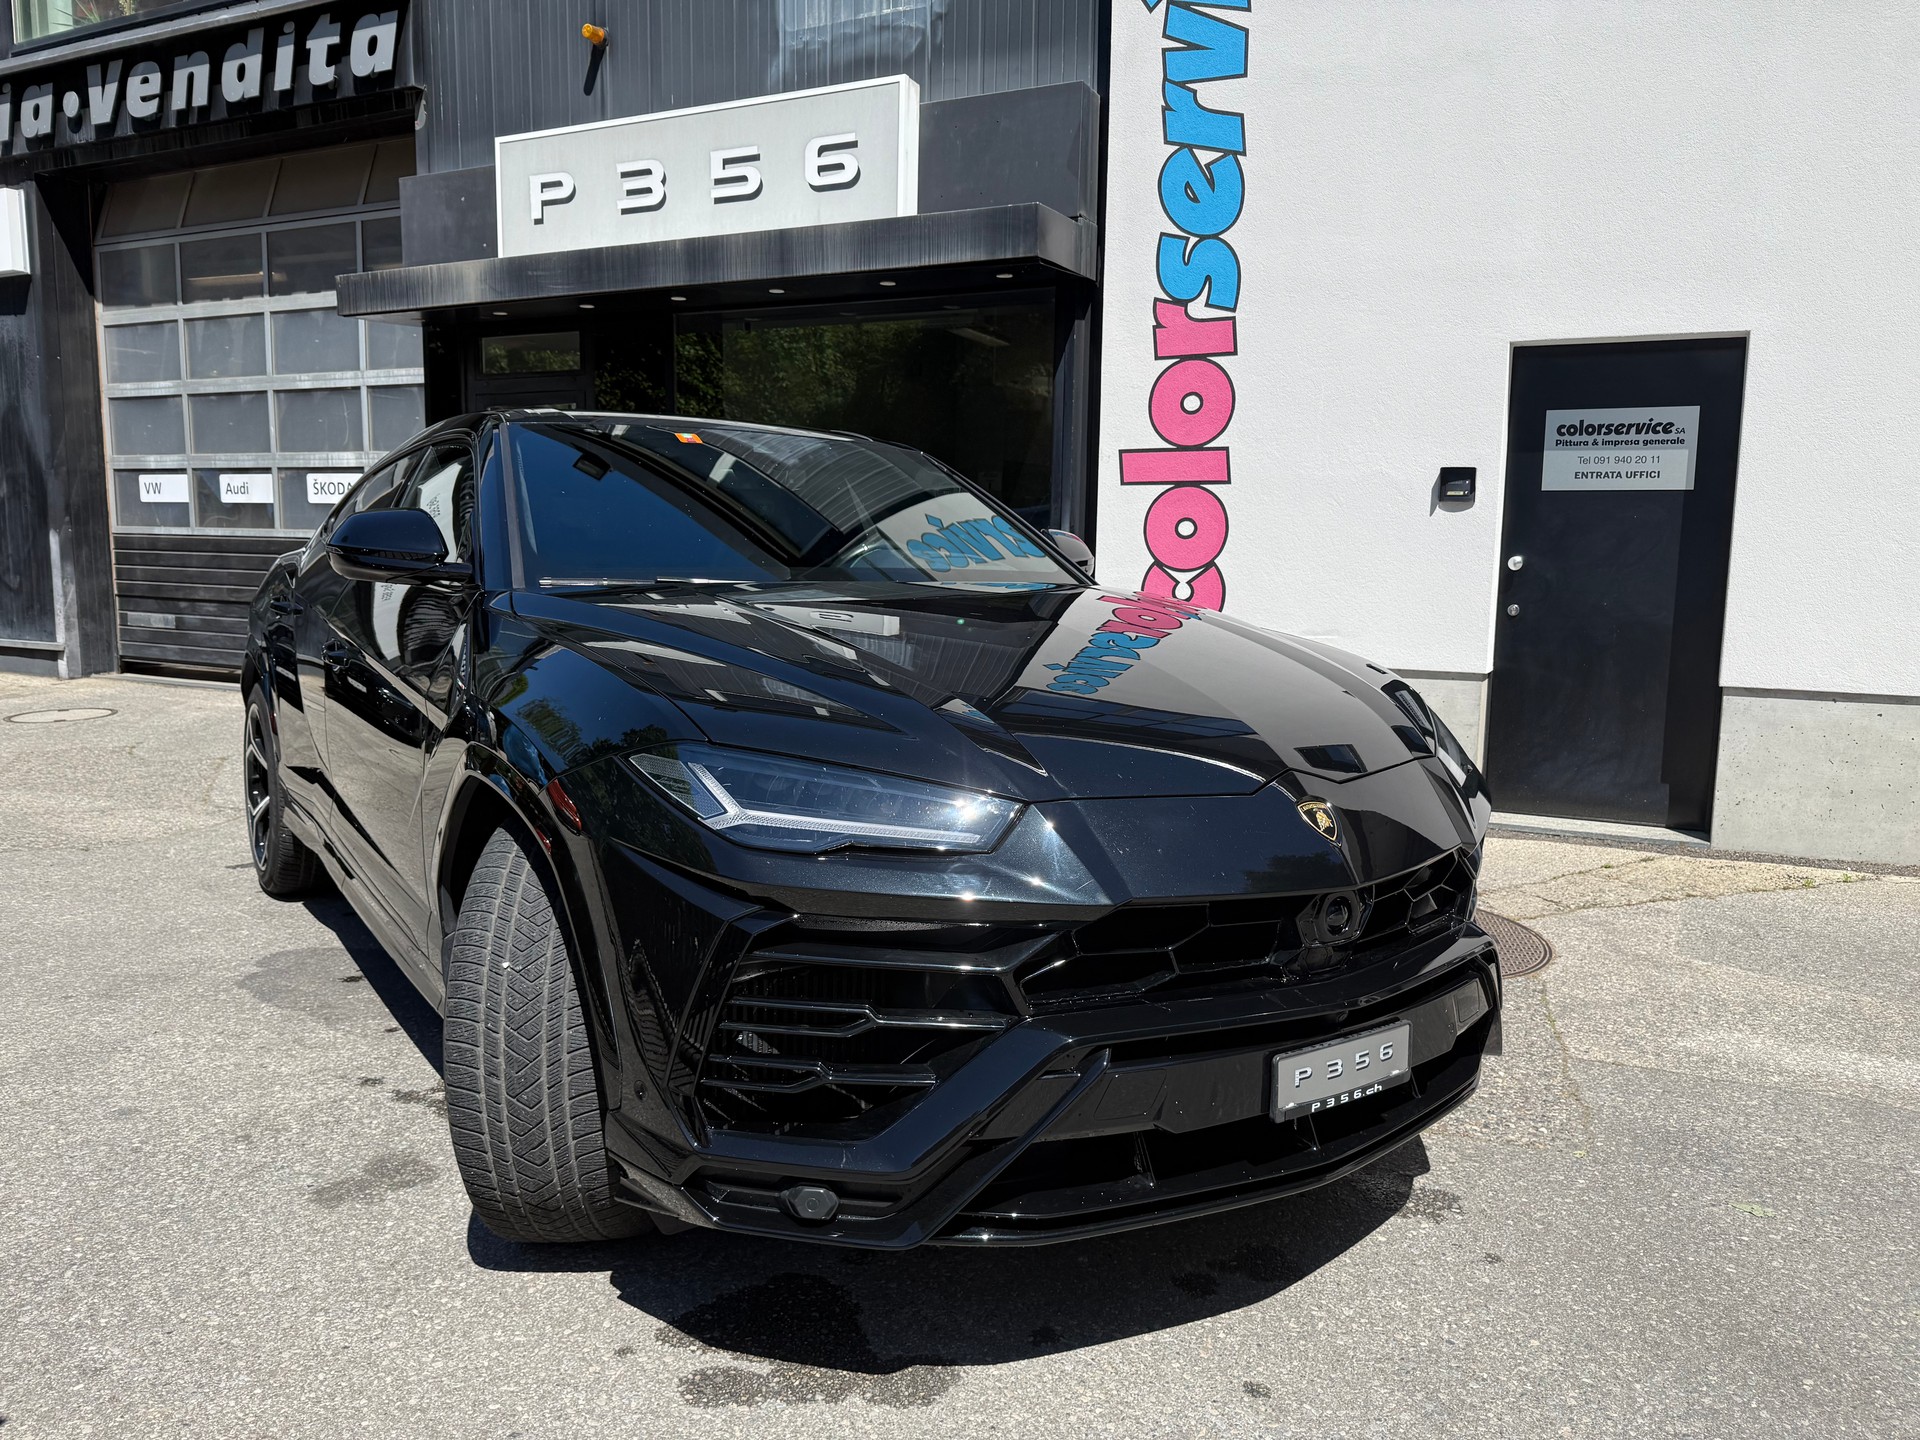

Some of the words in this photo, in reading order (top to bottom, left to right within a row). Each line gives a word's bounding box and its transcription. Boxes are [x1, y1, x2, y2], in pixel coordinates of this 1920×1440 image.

[1556, 418, 1675, 437] colorservice
[1674, 427, 1686, 435] SA
[1555, 438, 1589, 447] Pittura
[1591, 439, 1599, 447] &
[1601, 438, 1640, 448] impresa
[1642, 437, 1686, 447] generale
[1577, 456, 1591, 465] Tel
[1593, 456, 1611, 465] 091
[1613, 455, 1633, 464] 940
[1634, 455, 1647, 464] 20
[1650, 455, 1661, 464] 11
[1574, 470, 1623, 480] ENTRATA
[1625, 470, 1661, 479] UFFICI
[143, 481, 162, 495] VW
[225, 481, 249, 495] Audi
